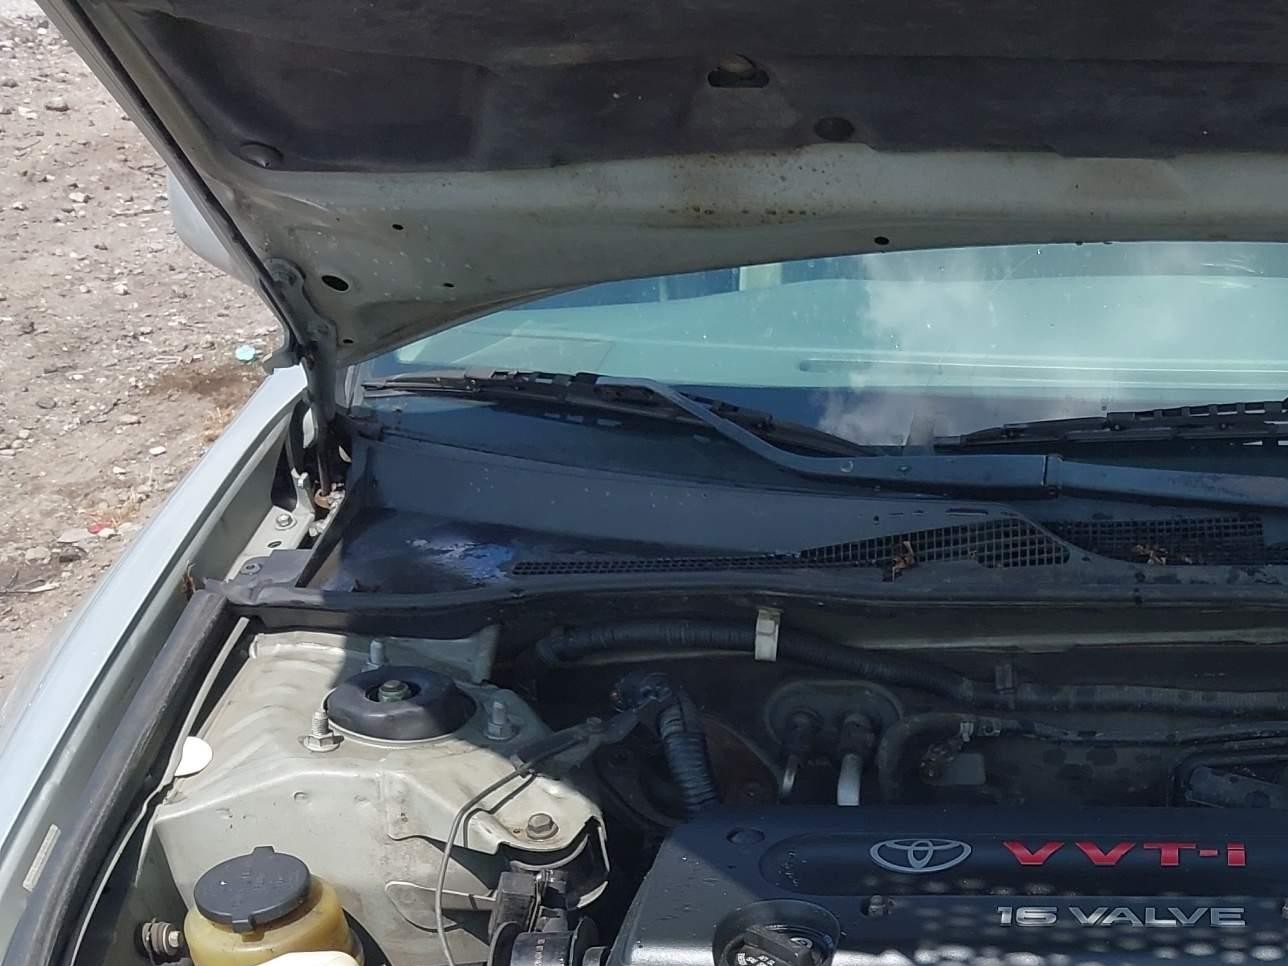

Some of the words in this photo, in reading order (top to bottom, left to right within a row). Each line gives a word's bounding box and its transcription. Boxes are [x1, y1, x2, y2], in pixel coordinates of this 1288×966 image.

[1002, 841, 1246, 867] VVT-i
[998, 906, 1057, 926] 16
[1069, 906, 1246, 927] VALVE
